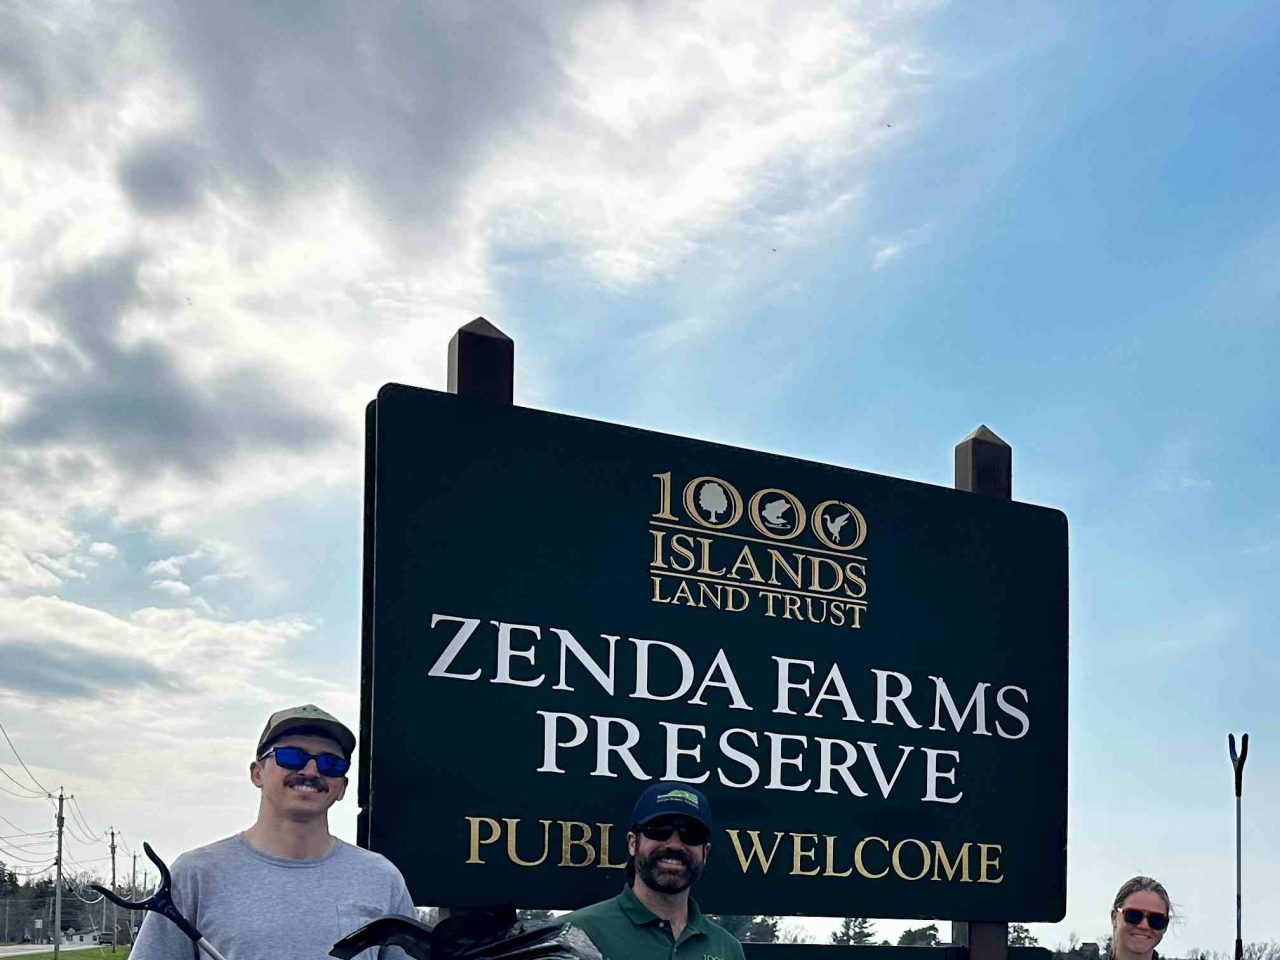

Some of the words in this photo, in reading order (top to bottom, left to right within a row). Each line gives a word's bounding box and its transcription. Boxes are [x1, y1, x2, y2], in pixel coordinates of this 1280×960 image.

[652, 471, 867, 551] 1000
[649, 529, 867, 598] ISLANDS
[650, 576, 749, 612] LAND
[759, 591, 867, 629] TRUST
[427, 613, 754, 711] ZENDA
[771, 655, 1030, 740] FARMS
[535, 710, 964, 804] PRESERVE
[464, 816, 627, 869] PUBL
[726, 829, 1004, 886] WELCOME
